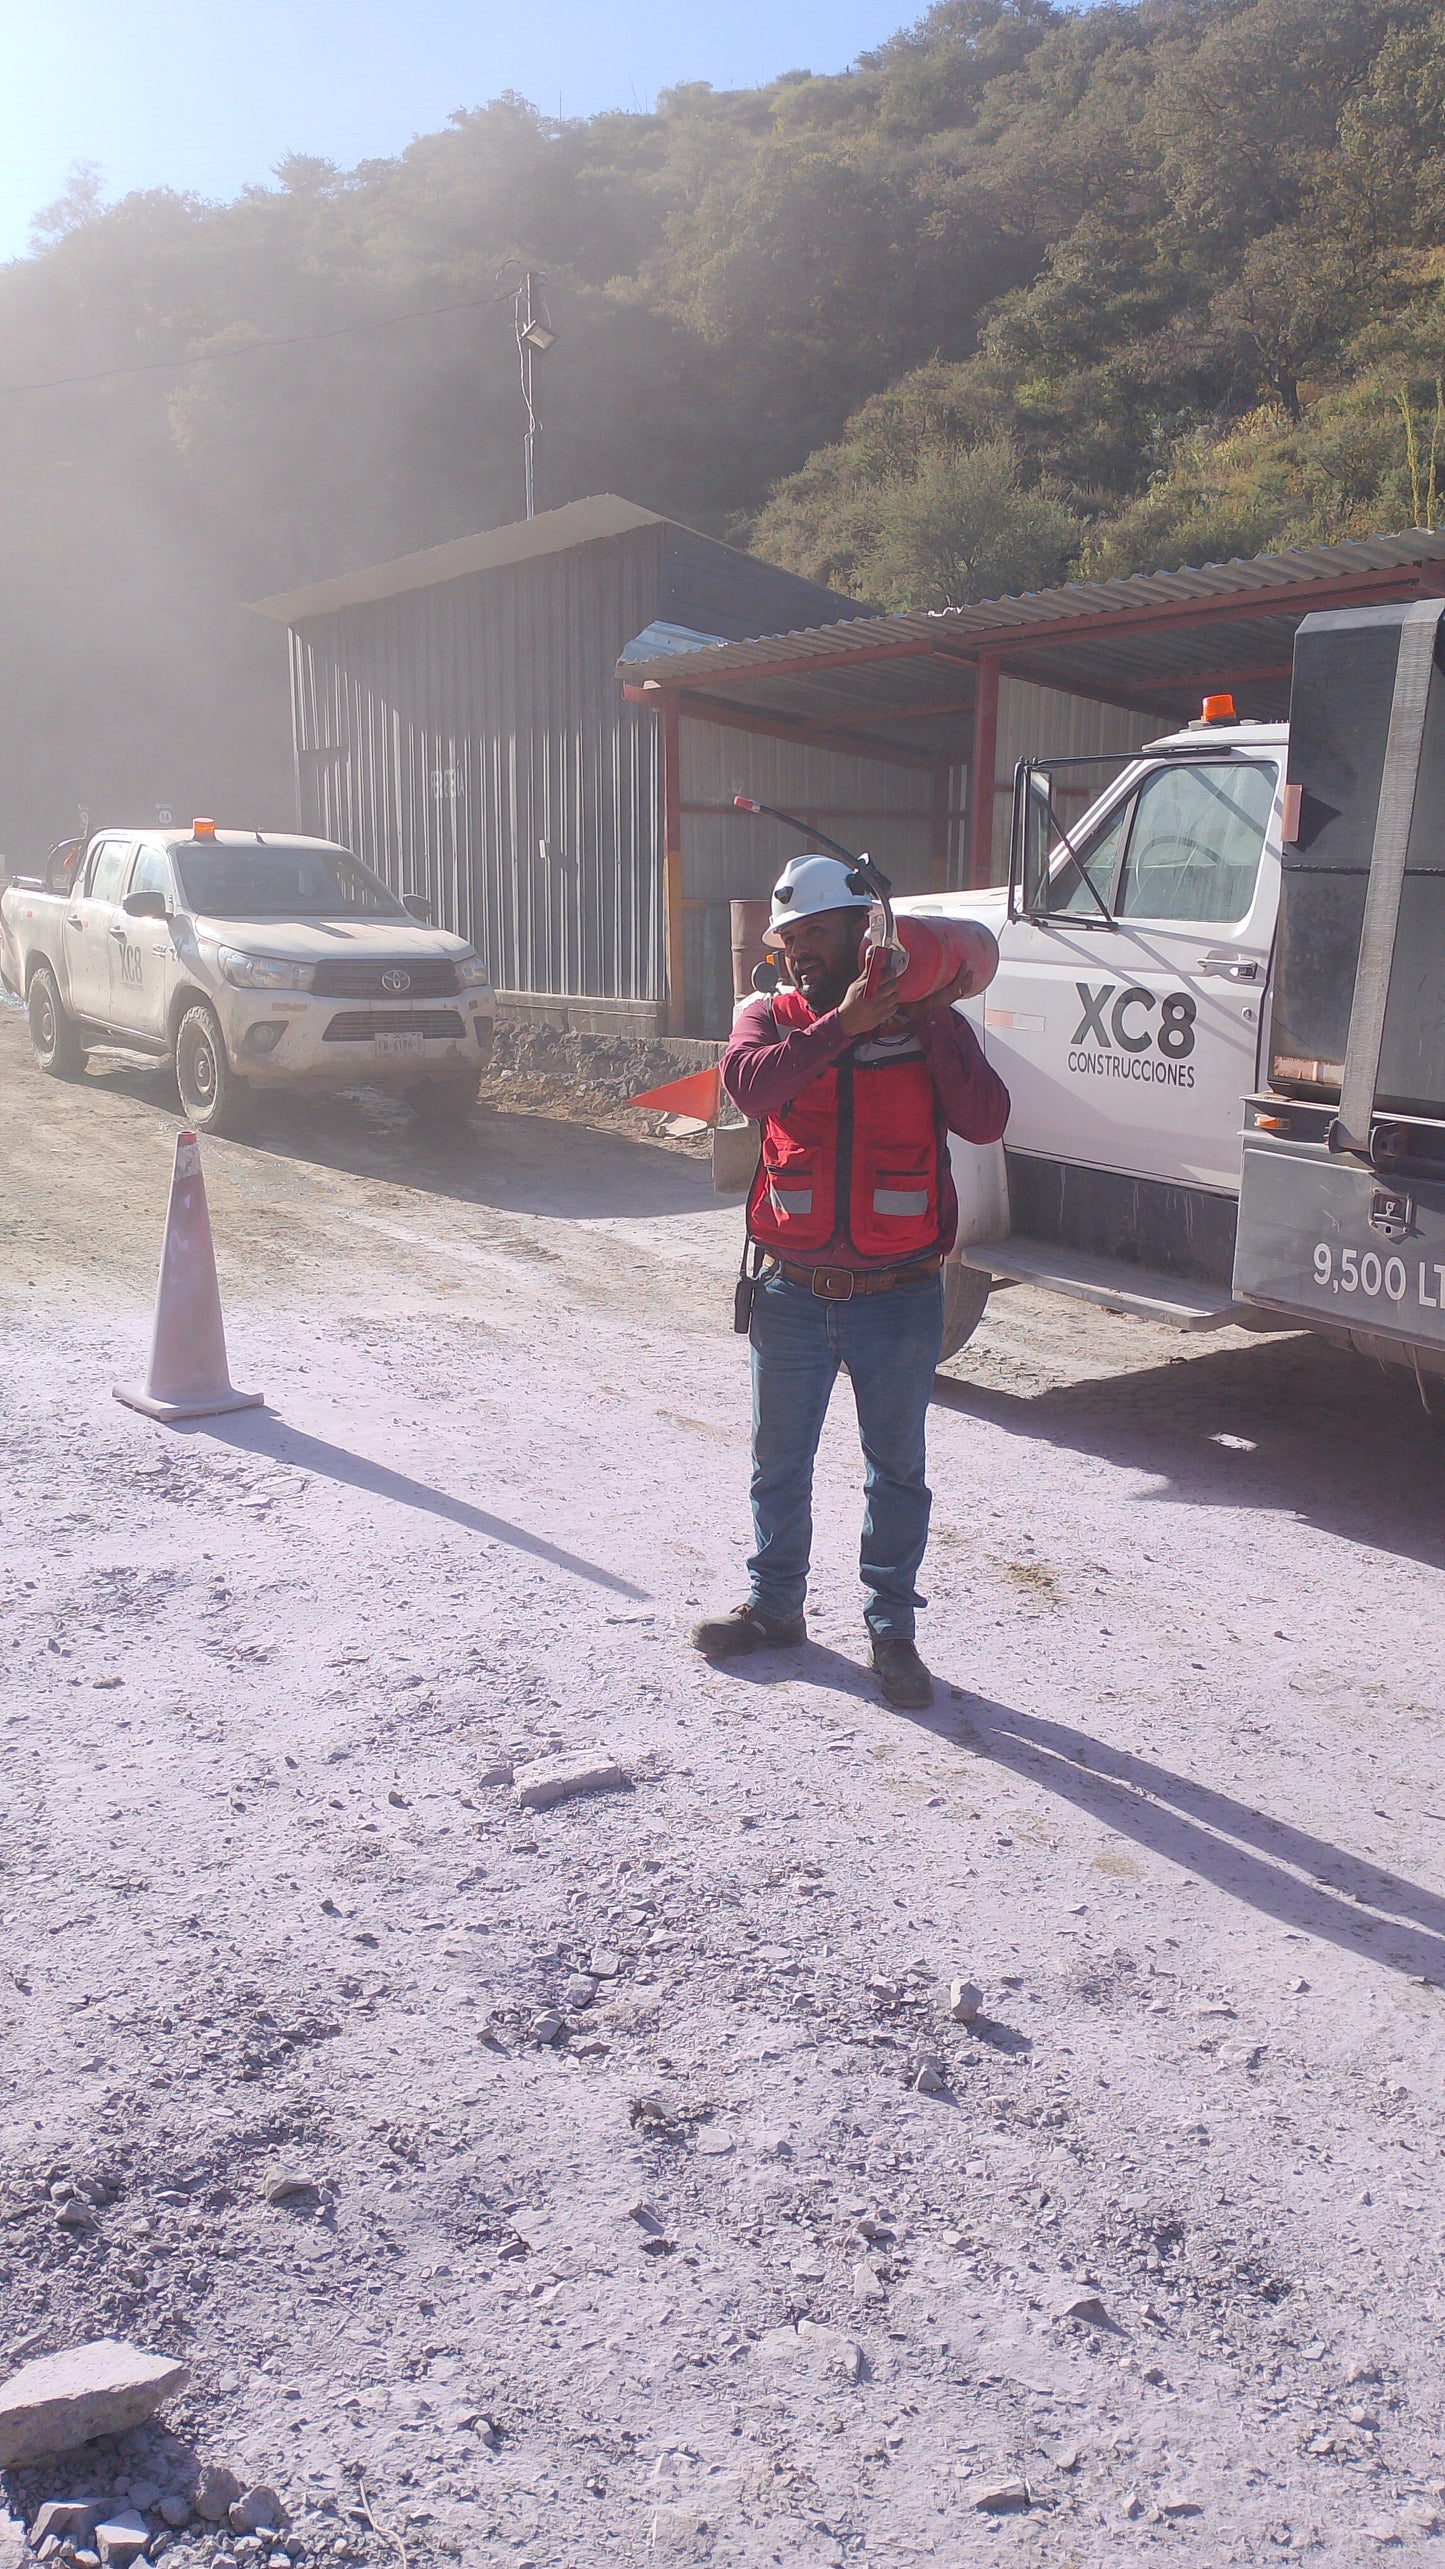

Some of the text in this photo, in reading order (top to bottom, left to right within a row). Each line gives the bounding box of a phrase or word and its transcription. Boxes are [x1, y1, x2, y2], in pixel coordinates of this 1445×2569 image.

[119, 943, 143, 983] XC8
[1070, 982, 1197, 1060] XC8
[1068, 1051, 1195, 1089] CONSTRUCCIONES
[1313, 1242, 1407, 1301] 9,500
